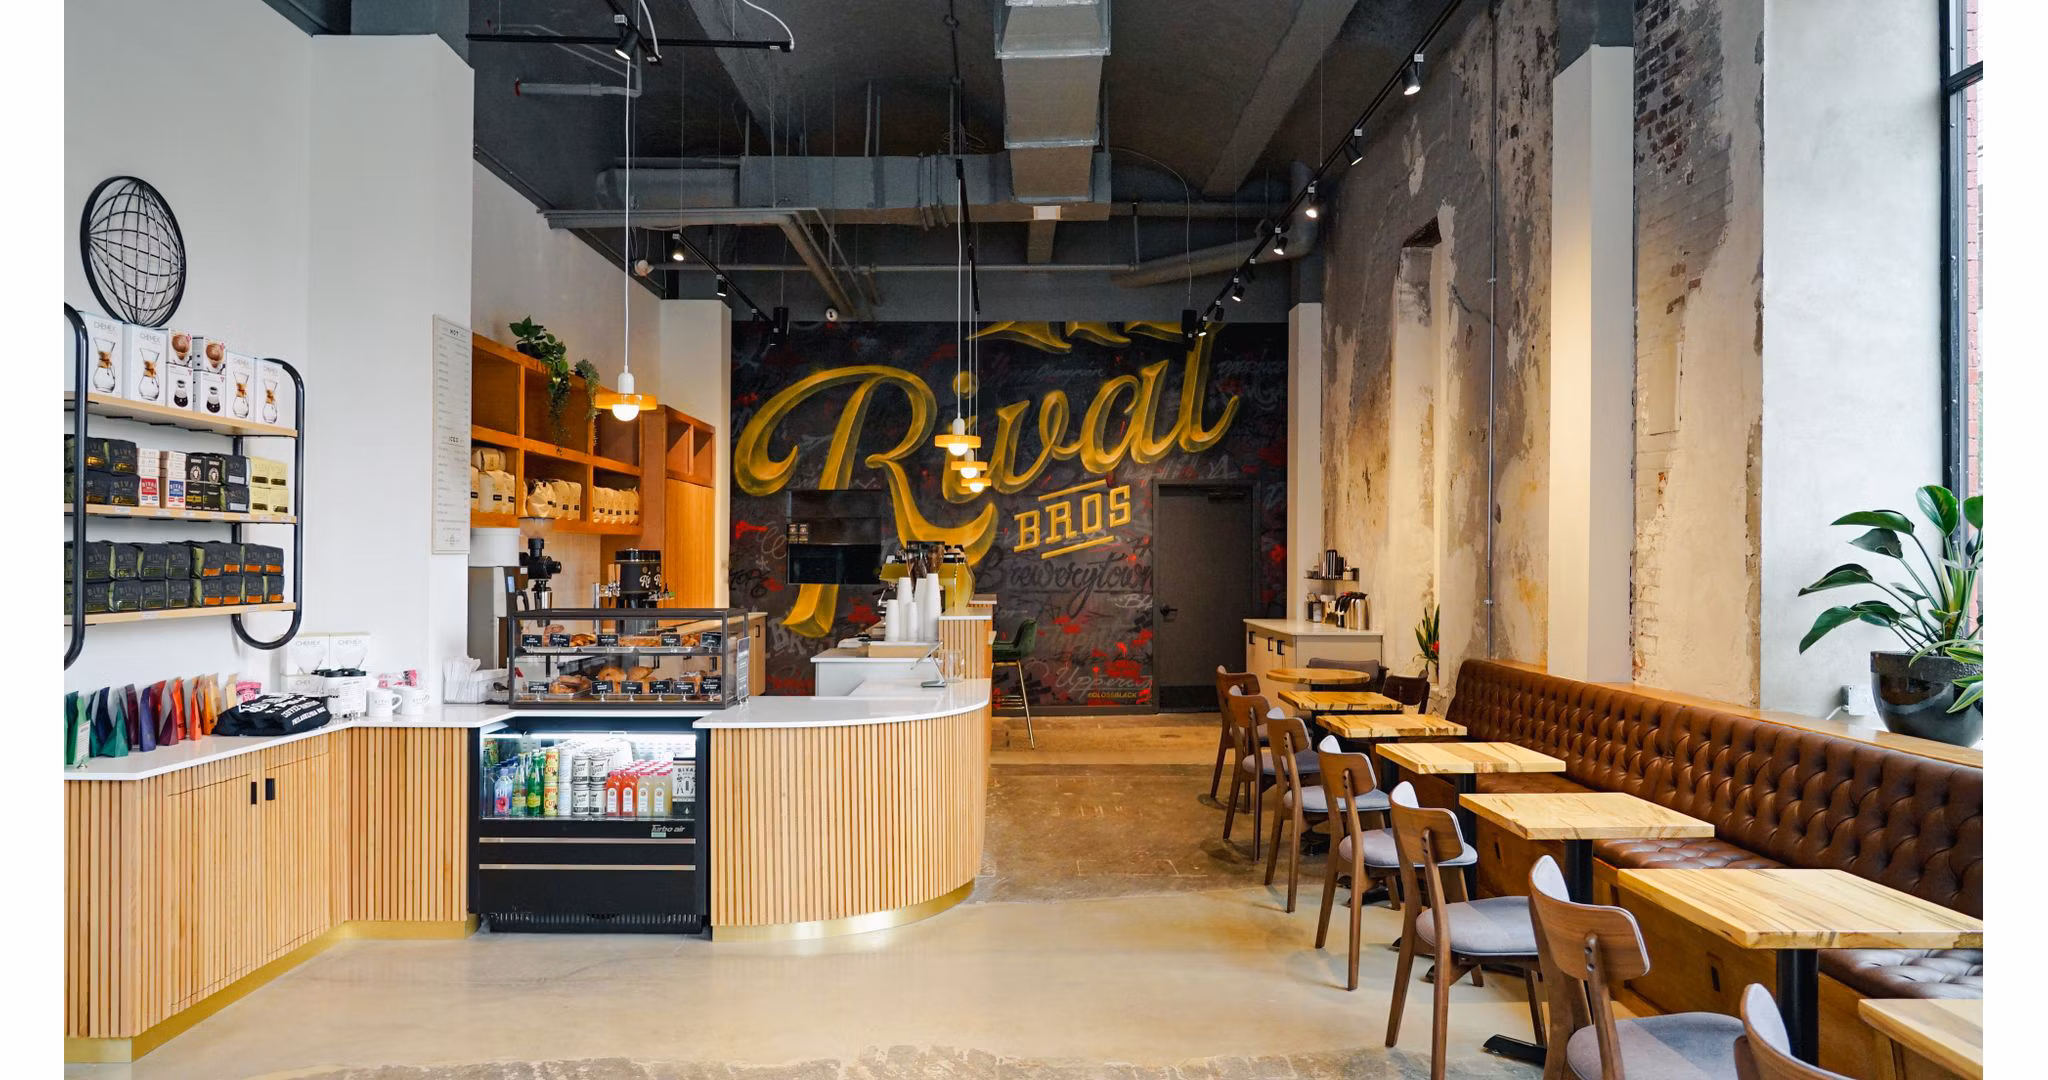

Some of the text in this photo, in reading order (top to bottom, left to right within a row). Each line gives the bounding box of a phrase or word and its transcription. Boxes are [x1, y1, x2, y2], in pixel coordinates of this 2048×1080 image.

[735, 322, 1239, 638] Rival
[1014, 485, 1131, 553] BROS
[975, 550, 1152, 618] Brewerytown
[651, 824, 686, 833] Turbo air
